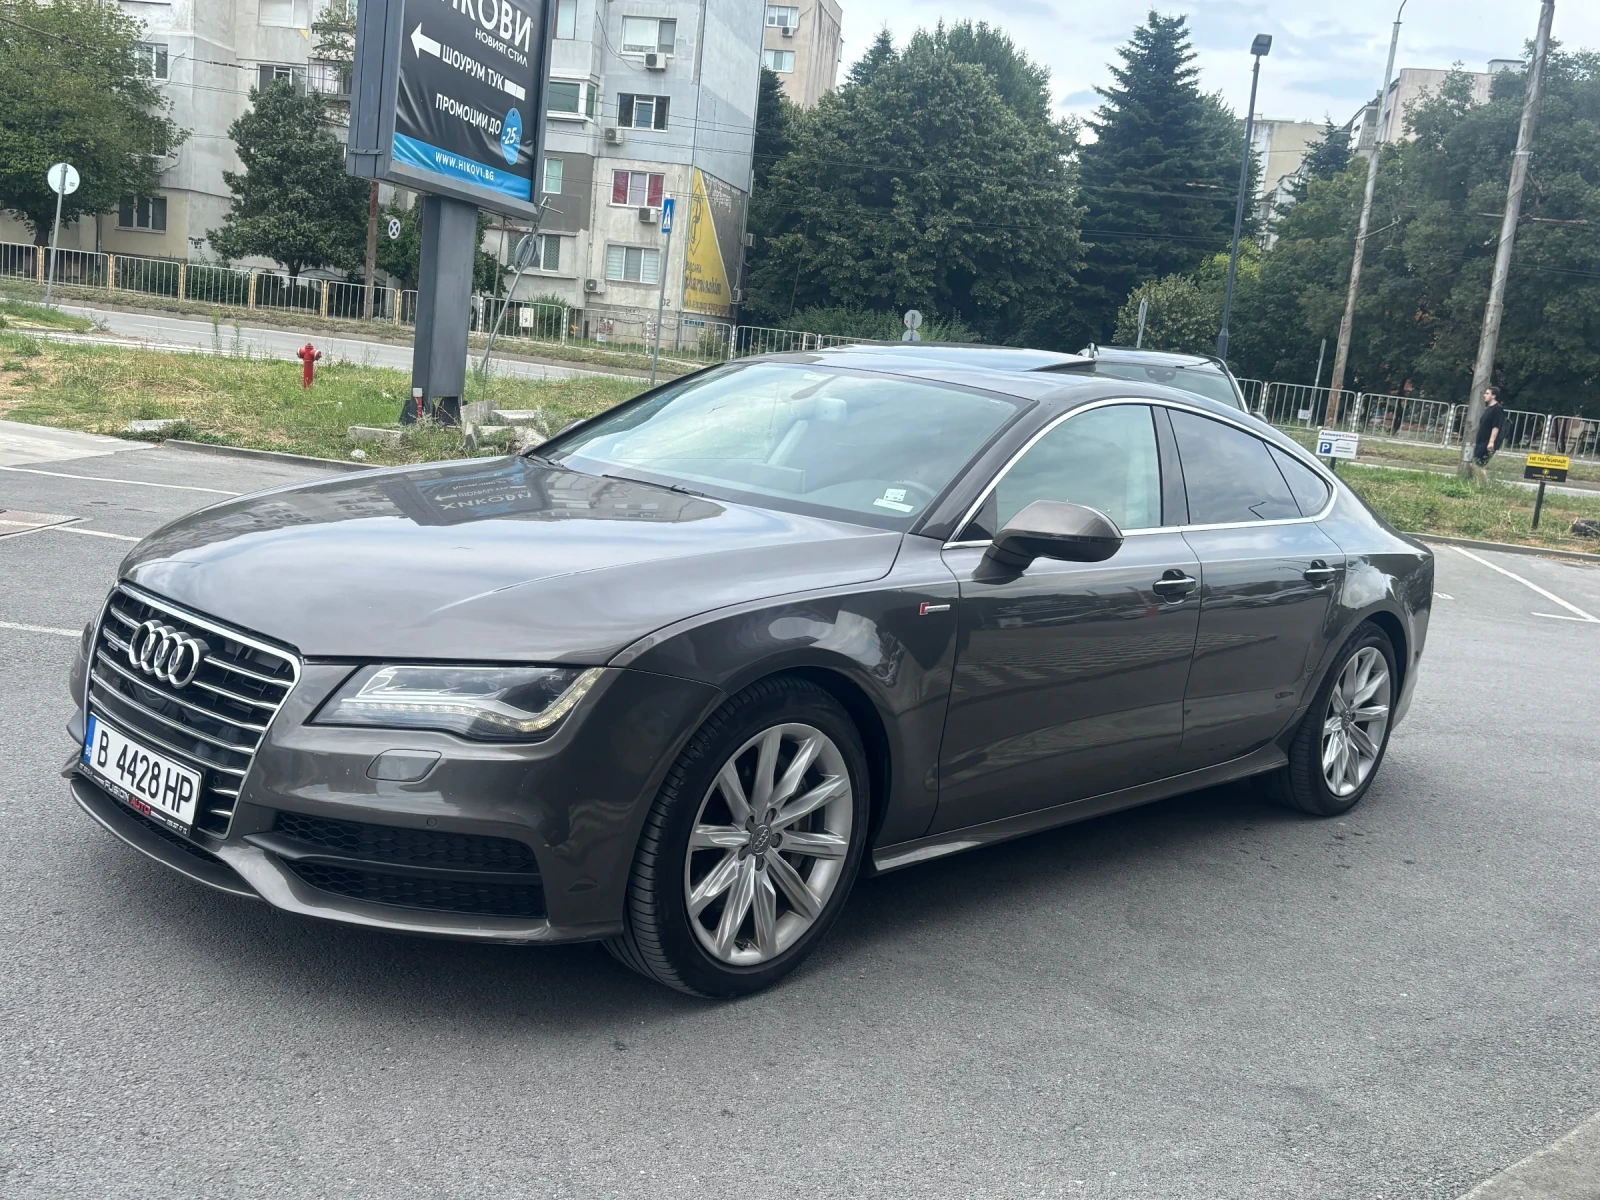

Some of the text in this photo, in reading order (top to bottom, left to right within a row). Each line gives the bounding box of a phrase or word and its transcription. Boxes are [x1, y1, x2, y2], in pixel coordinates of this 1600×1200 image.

[442, 44, 505, 91] ШОУРУМ ТУК
[475, 28, 528, 68] НОВИЯТ СТИЛ
[436, 93, 488, 128] ПРОМОЦИИ
[488, 116, 502, 136] ДО
[435, 151, 494, 181] WWW.HIKOVI.BG
[97, 729, 193, 814] B 4428 HP
[104, 779, 152, 816] FUSION AUTO
